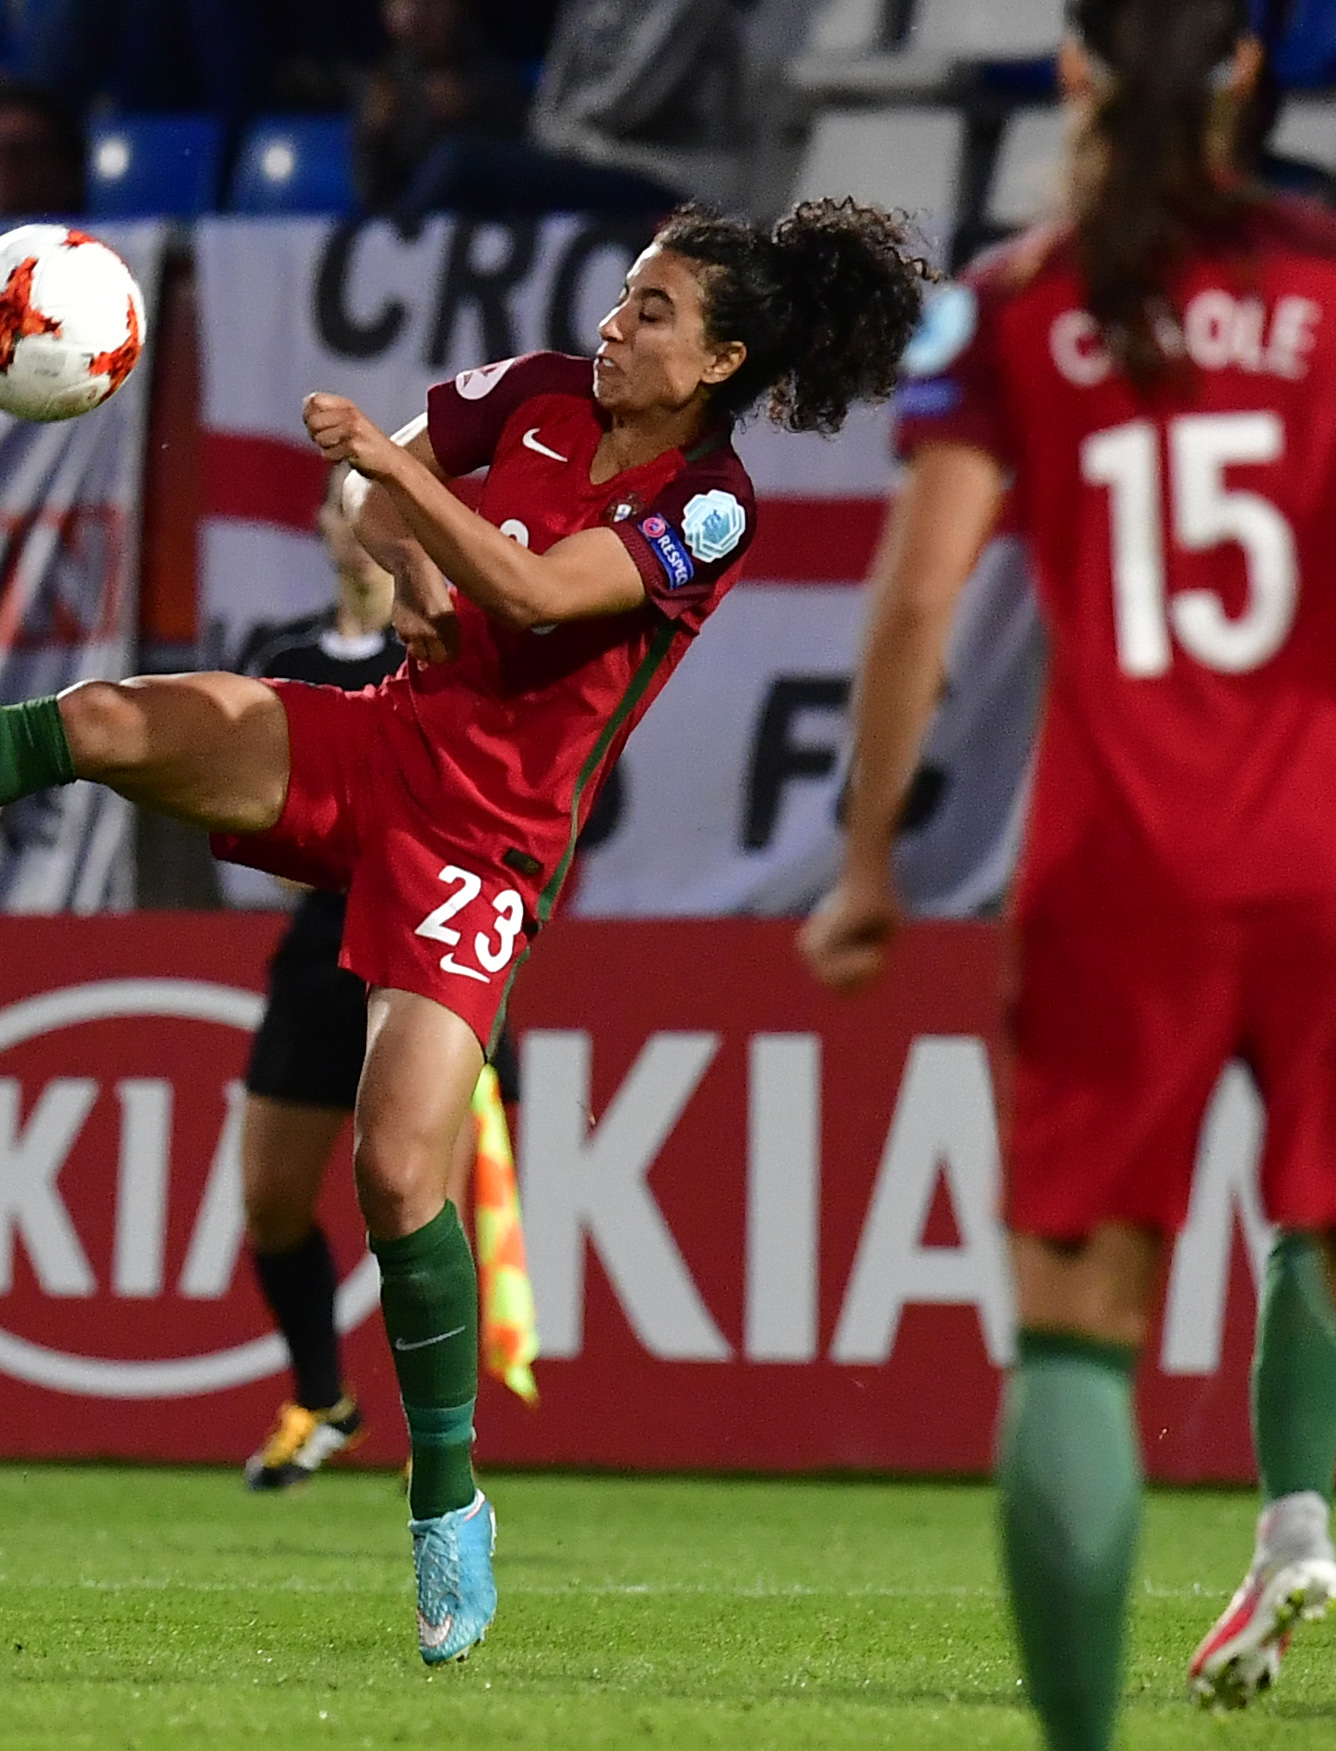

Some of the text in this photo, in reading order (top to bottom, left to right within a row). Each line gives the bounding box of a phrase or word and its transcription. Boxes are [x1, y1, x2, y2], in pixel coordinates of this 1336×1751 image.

[1049, 289, 1323, 388] COLE
[1079, 410, 1302, 679] 15
[414, 864, 524, 973] 23
[519, 1029, 1018, 1367] KIA
